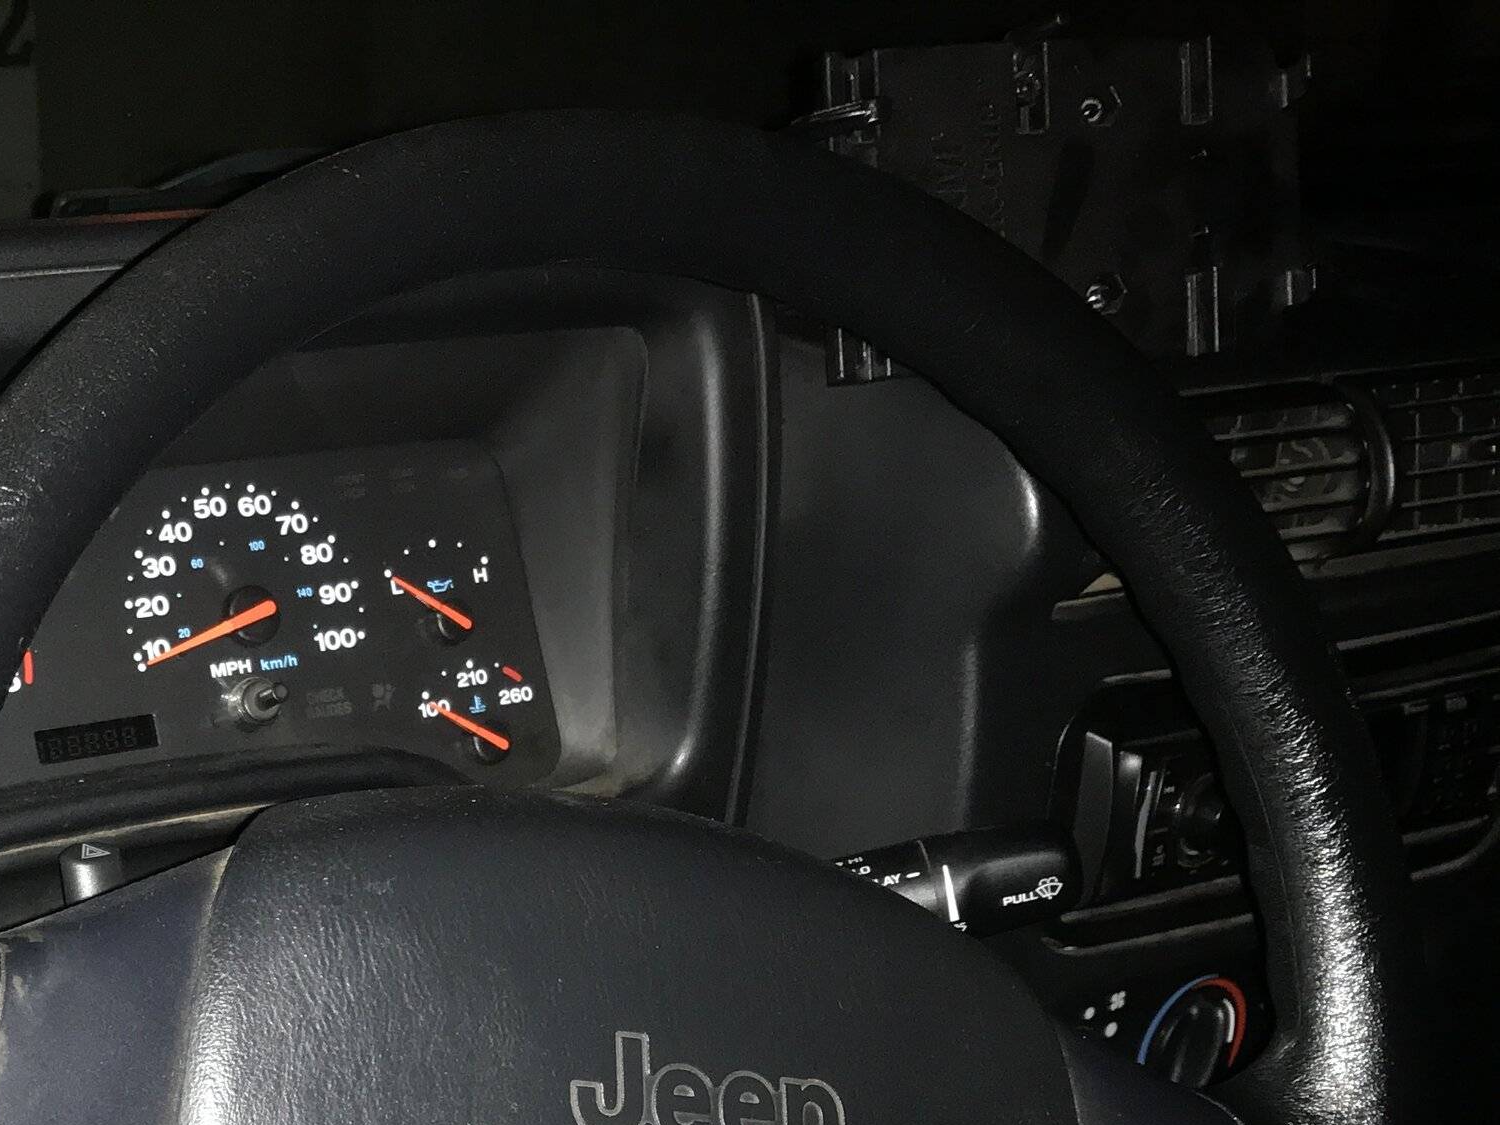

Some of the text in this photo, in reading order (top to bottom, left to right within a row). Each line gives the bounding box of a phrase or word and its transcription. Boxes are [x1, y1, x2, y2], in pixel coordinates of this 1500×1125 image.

[194, 495, 227, 519] 50
[238, 494, 272, 517] 60
[159, 522, 192, 543] 40
[275, 513, 308, 535] 70
[249, 540, 265, 551] 100
[301, 543, 334, 565] 80
[142, 556, 176, 578] 30
[473, 567, 488, 583] H
[319, 581, 353, 605] 90
[135, 595, 169, 618] 20
[142, 639, 171, 663] 10
[314, 628, 356, 652] 100
[210, 655, 297, 678] MPH km/h
[457, 669, 487, 687] 210
[499, 686, 532, 705] 260
[418, 698, 450, 718] 100
[1003, 890, 1037, 906] PULL
